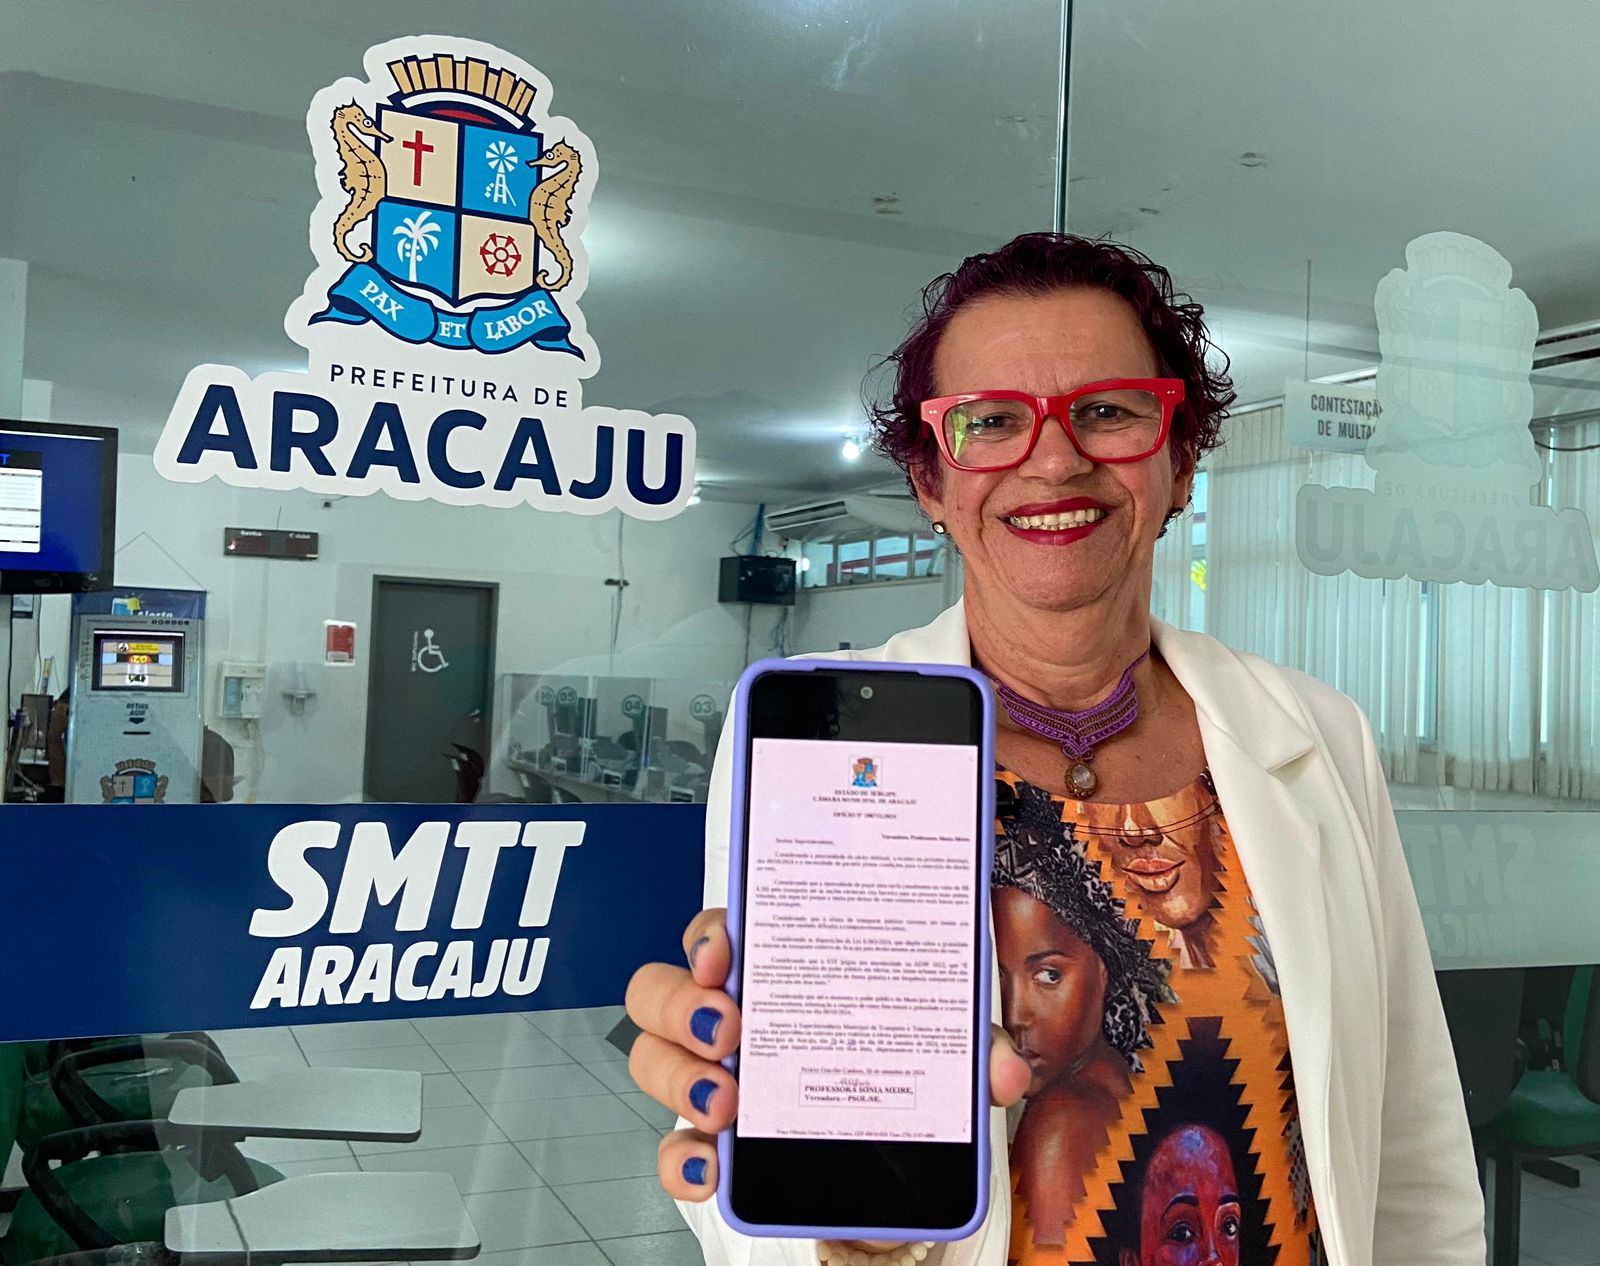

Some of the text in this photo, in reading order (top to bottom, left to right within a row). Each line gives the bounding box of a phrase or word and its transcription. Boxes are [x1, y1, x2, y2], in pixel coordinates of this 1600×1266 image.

[359, 279, 553, 341] PAX ET LABOR
[330, 364, 569, 408] PREFEITURA DE
[176, 383, 684, 506] ARACAJU
[1317, 419, 1332, 437] DE
[625, 701, 642, 711] 04
[694, 701, 712, 713] 03
[248, 820, 587, 938] SMTT
[249, 937, 551, 1010] ARACAJU
[804, 1085, 857, 1093] PROFESSORA
